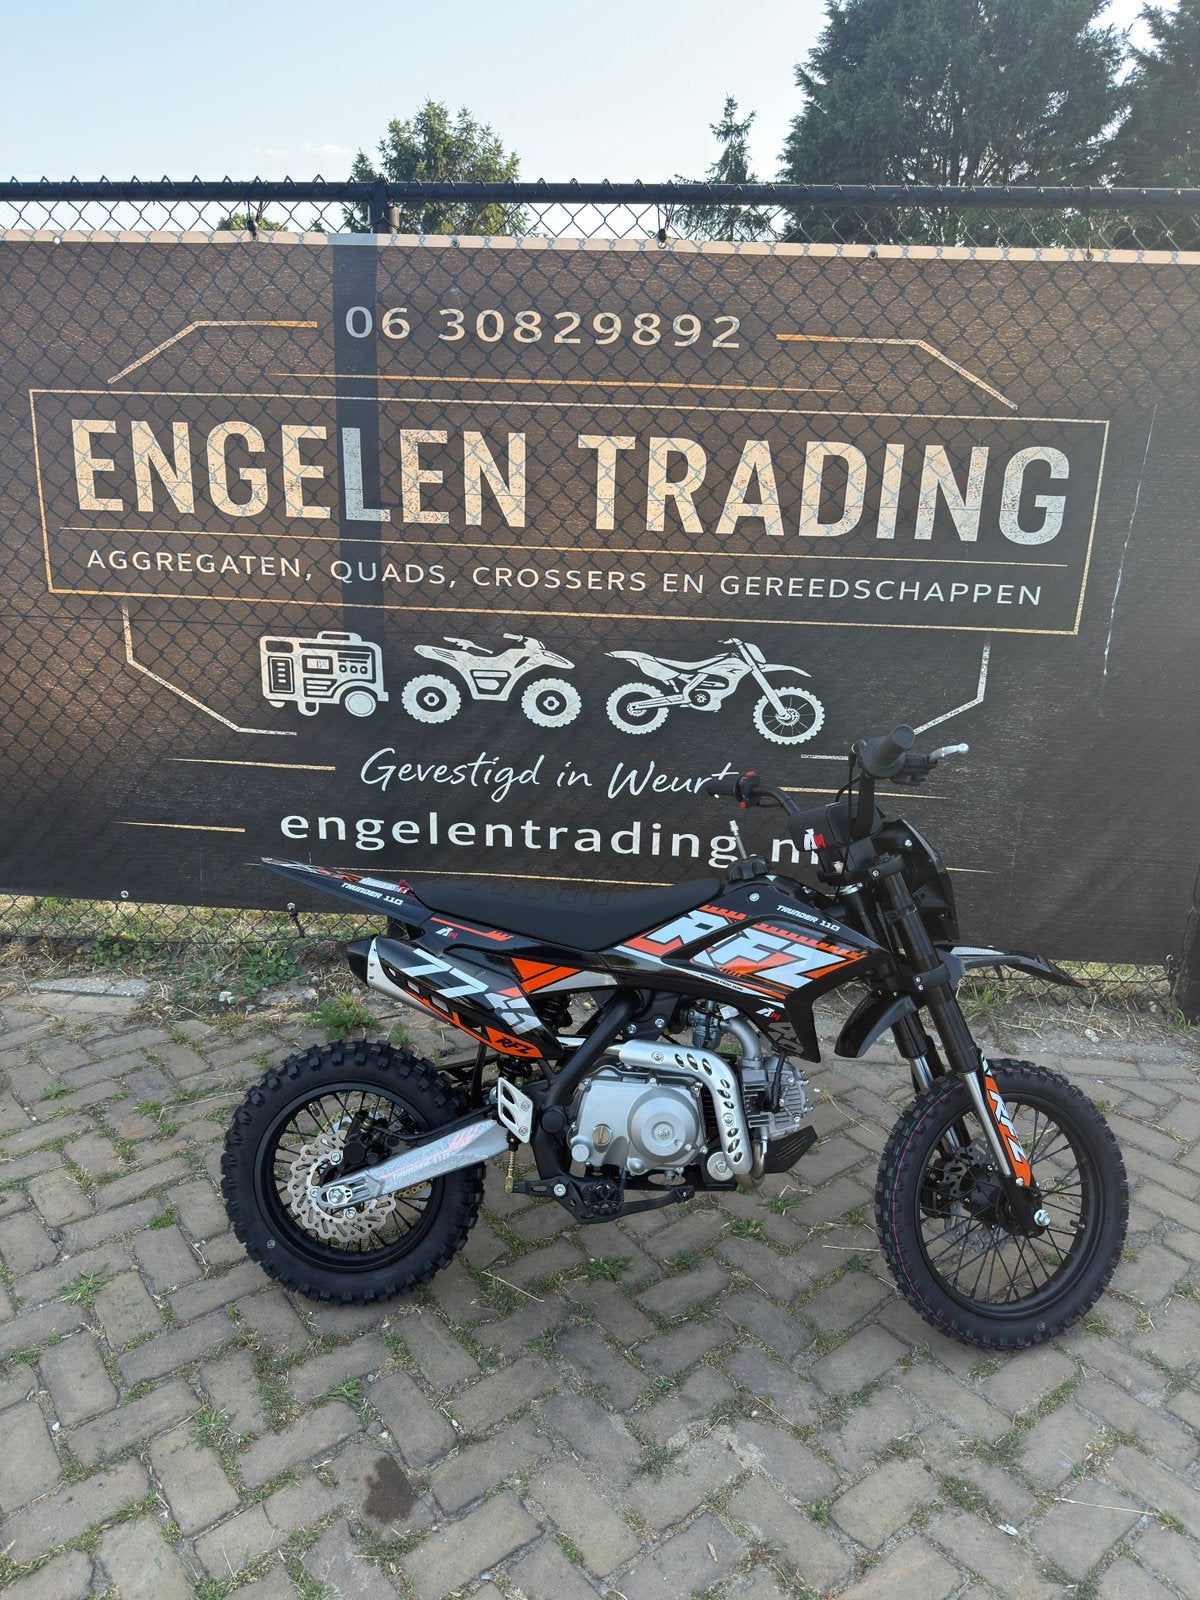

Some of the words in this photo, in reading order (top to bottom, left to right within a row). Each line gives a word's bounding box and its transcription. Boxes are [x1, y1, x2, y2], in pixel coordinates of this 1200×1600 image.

[344, 306, 411, 340] 06
[438, 308, 741, 349] 30829892
[71, 418, 526, 528] ENGELEN
[577, 434, 1070, 546] TRADING
[86, 549, 312, 582] AGGREGATEN,
[330, 560, 456, 589] QUADS,
[472, 567, 646, 592] CROSSERS
[663, 574, 703, 594] EN
[720, 575, 1042, 606] GEREEDSCHAPPEN
[360, 747, 545, 803] Gevestigd
[557, 761, 592, 788] in
[280, 812, 819, 870] engelentradingn
[341, 882, 383, 899] THUNDER
[776, 904, 819, 923] THUNDER
[819, 920, 841, 932] 110
[495, 1036, 535, 1055] RFZ
